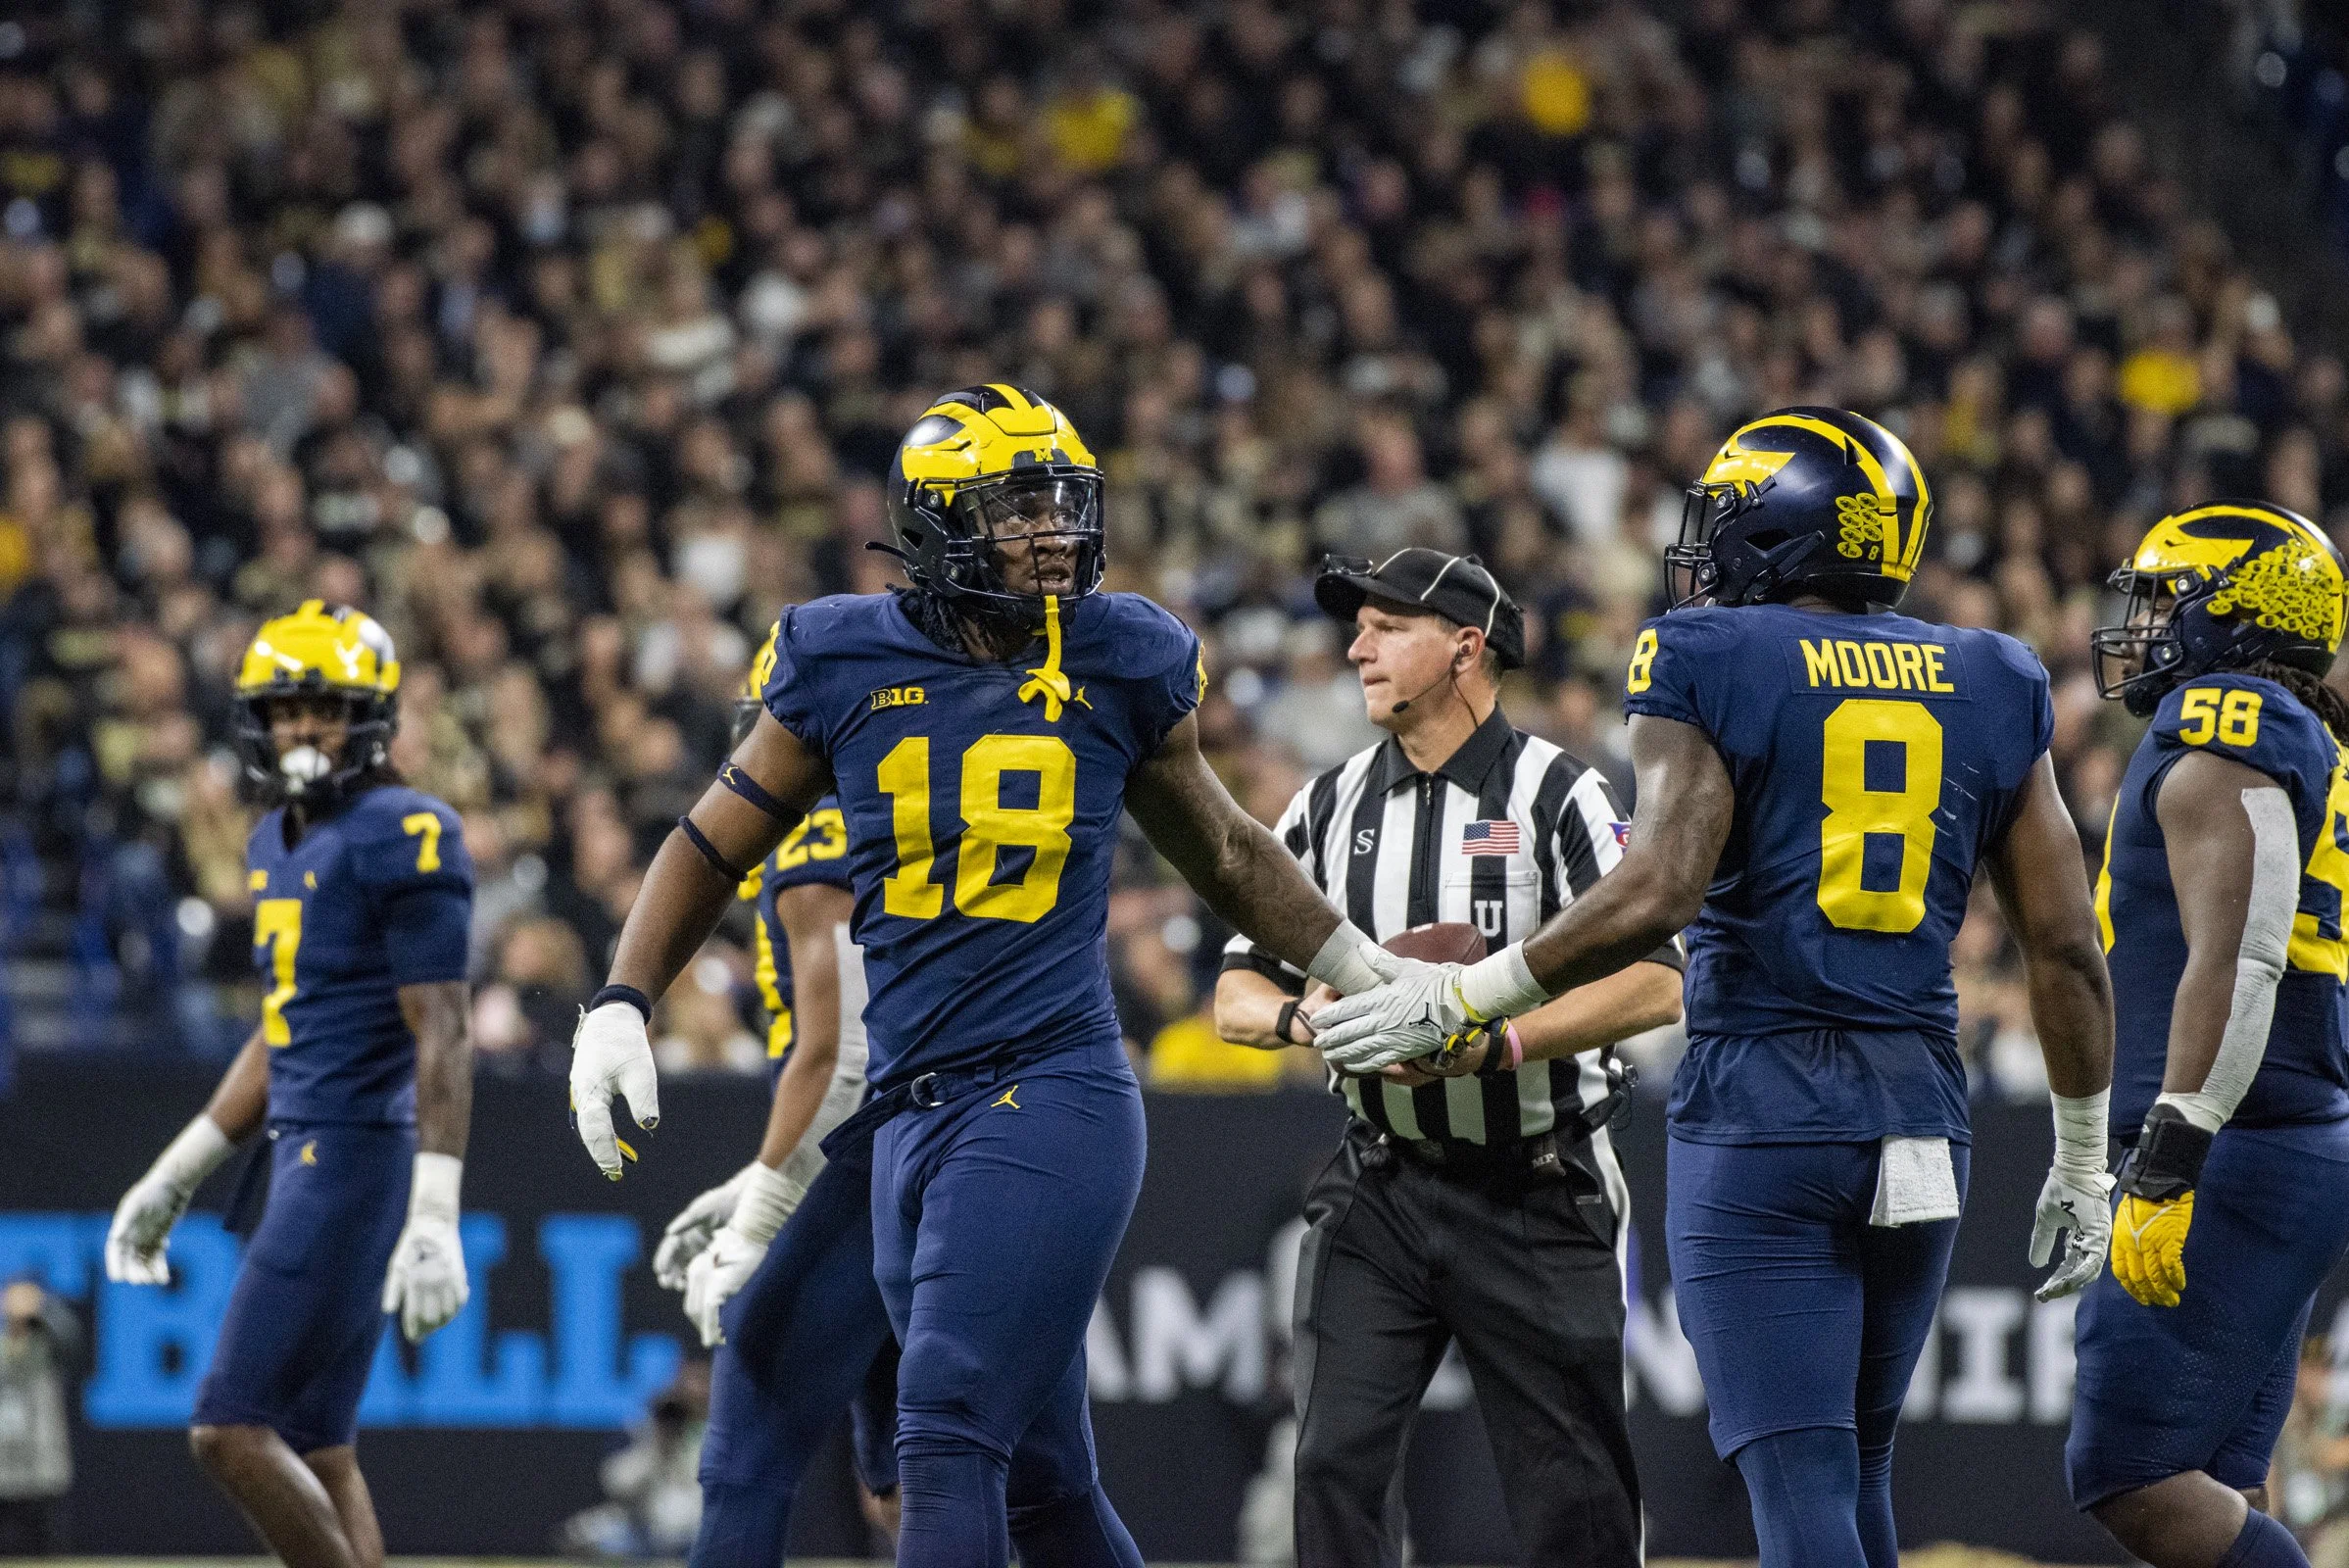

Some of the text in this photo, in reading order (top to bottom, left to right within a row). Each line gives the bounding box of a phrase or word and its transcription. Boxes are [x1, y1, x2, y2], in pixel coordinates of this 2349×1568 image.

[1627, 628, 1659, 695] 8
[1799, 639, 1955, 693] MOORE
[2178, 687, 2264, 748] 58
[403, 812, 441, 873] 7
[777, 808, 847, 871] 23
[877, 734, 1077, 923] 18
[1353, 829, 1375, 855] S
[1817, 699, 1943, 933] 8
[1474, 901, 1503, 937] U
[254, 898, 302, 1047] 7
[0, 1211, 683, 1427] BLL
